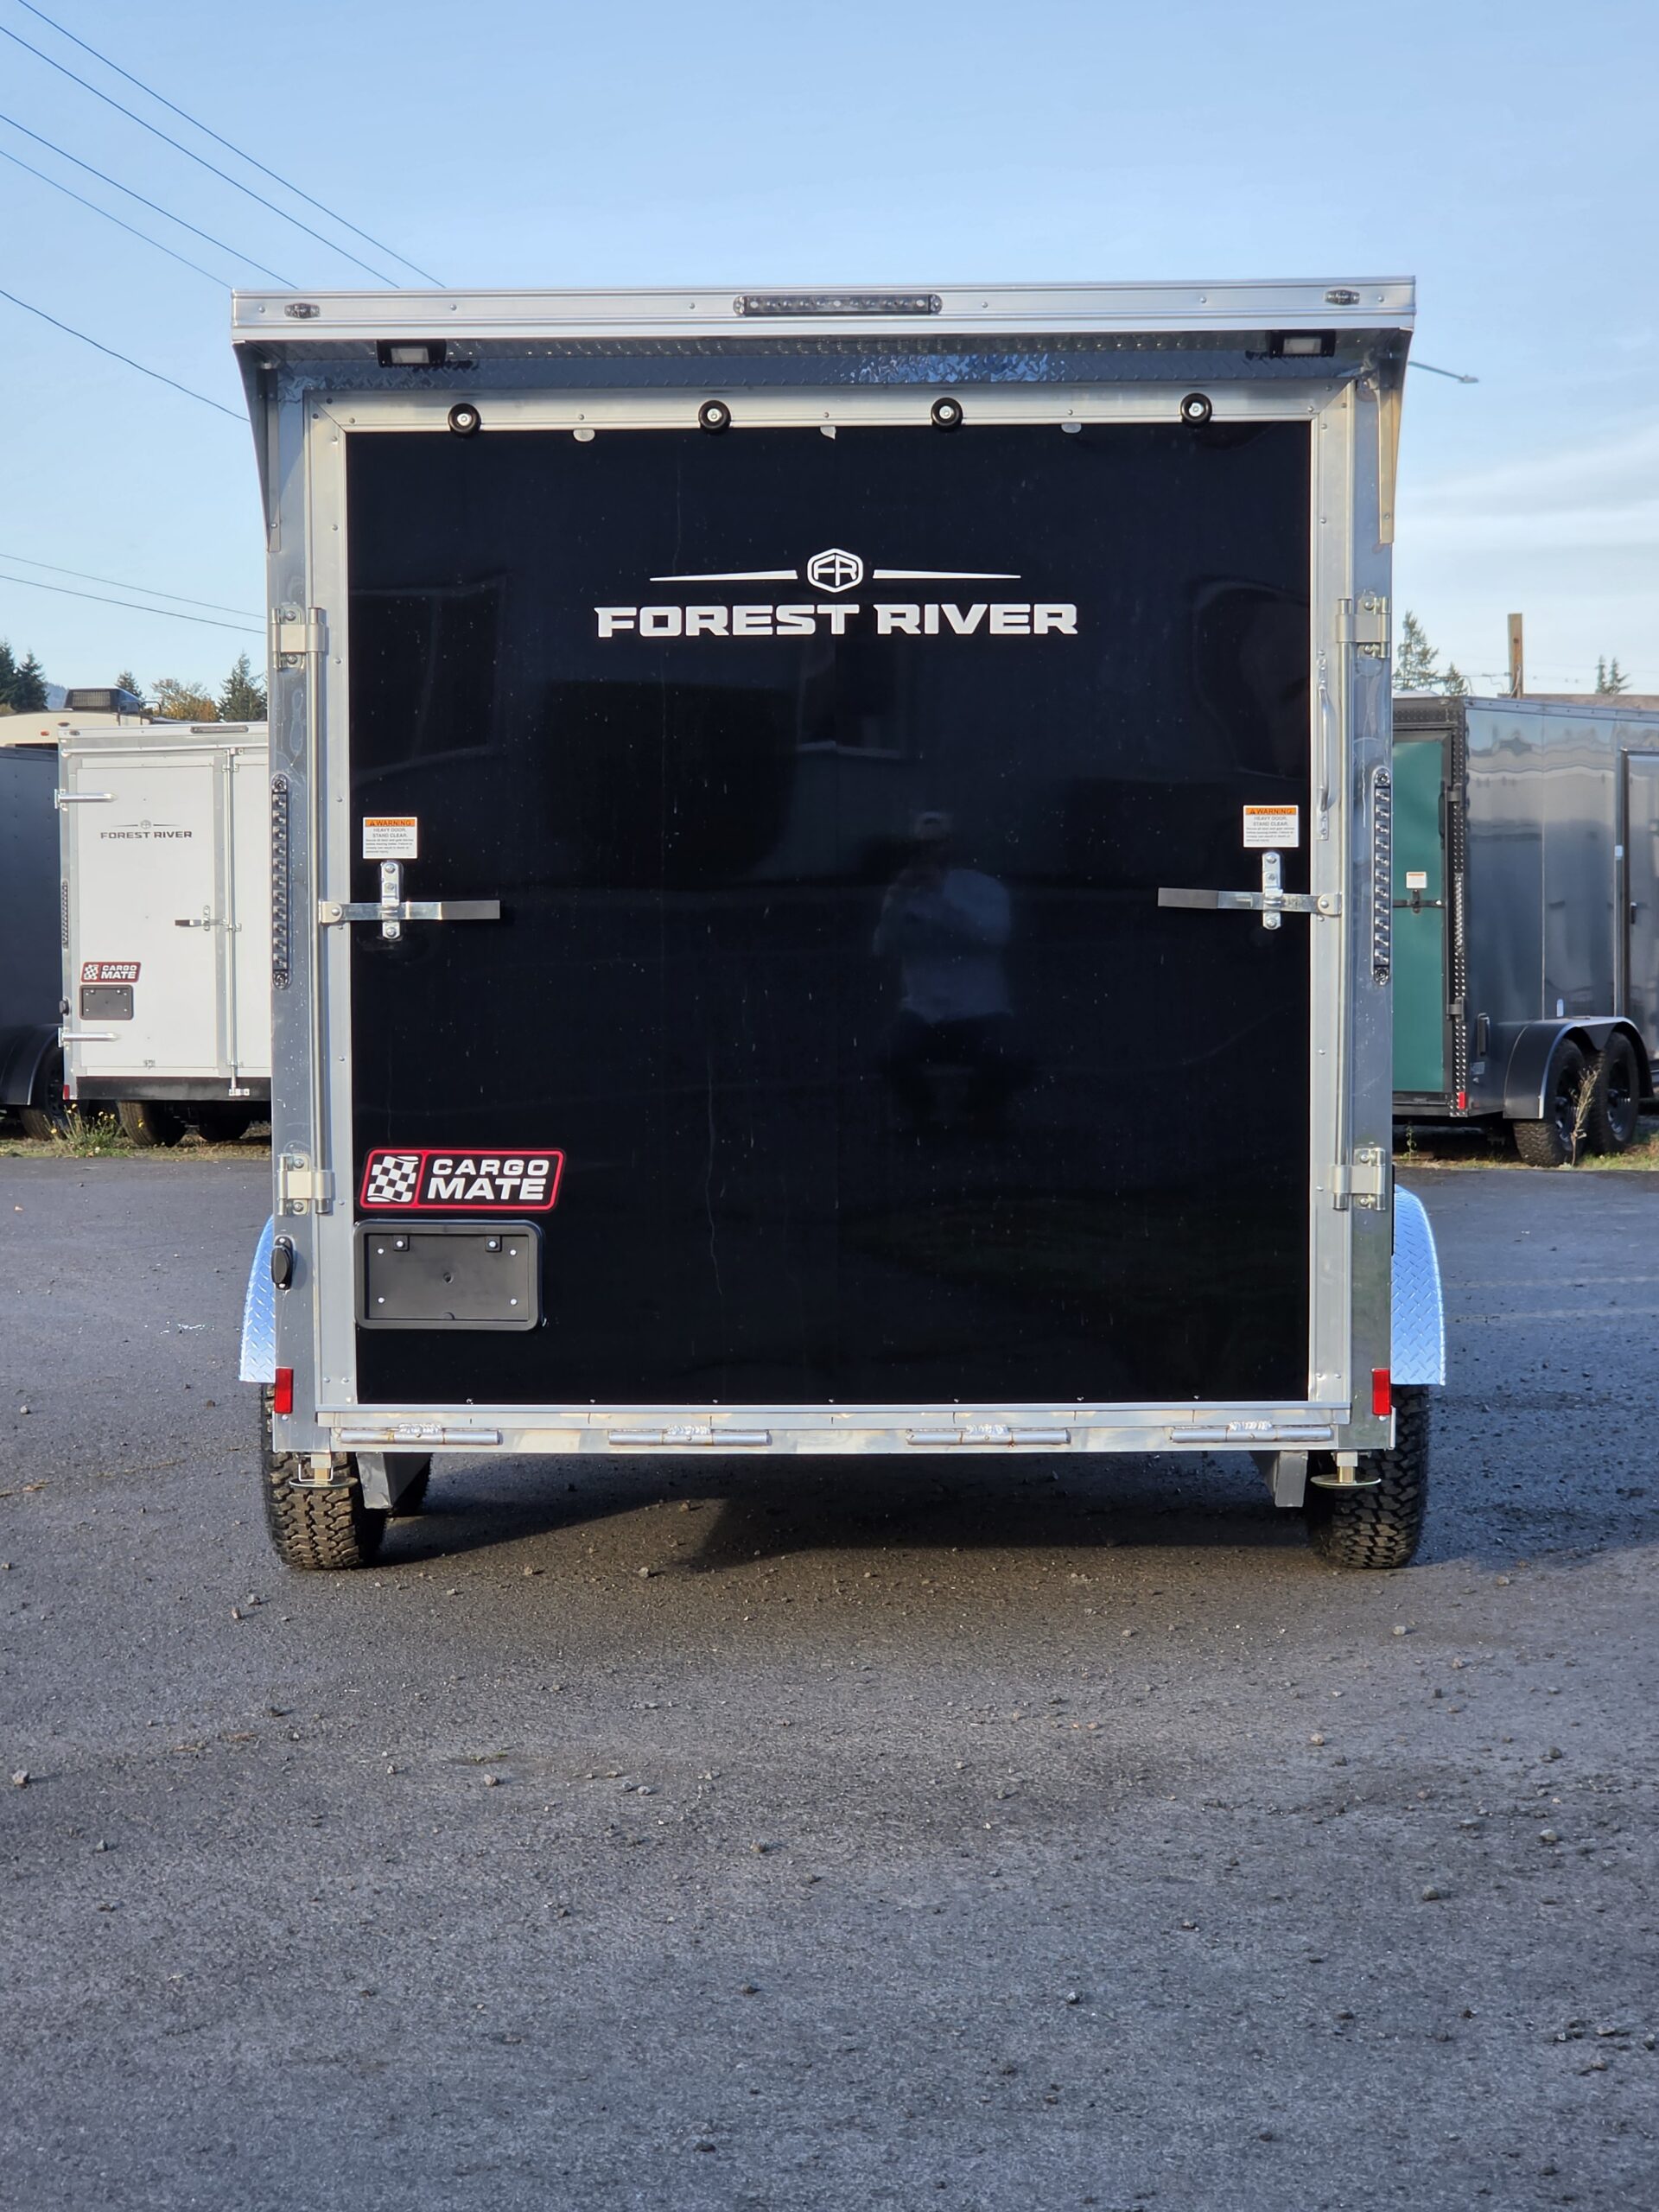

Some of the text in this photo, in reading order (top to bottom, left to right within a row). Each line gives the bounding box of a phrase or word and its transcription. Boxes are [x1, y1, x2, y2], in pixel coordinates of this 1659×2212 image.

[594, 603, 1078, 638] FOREST RIVER
[432, 1159, 550, 1176] CARGO
[427, 1177, 547, 1200] MATE
